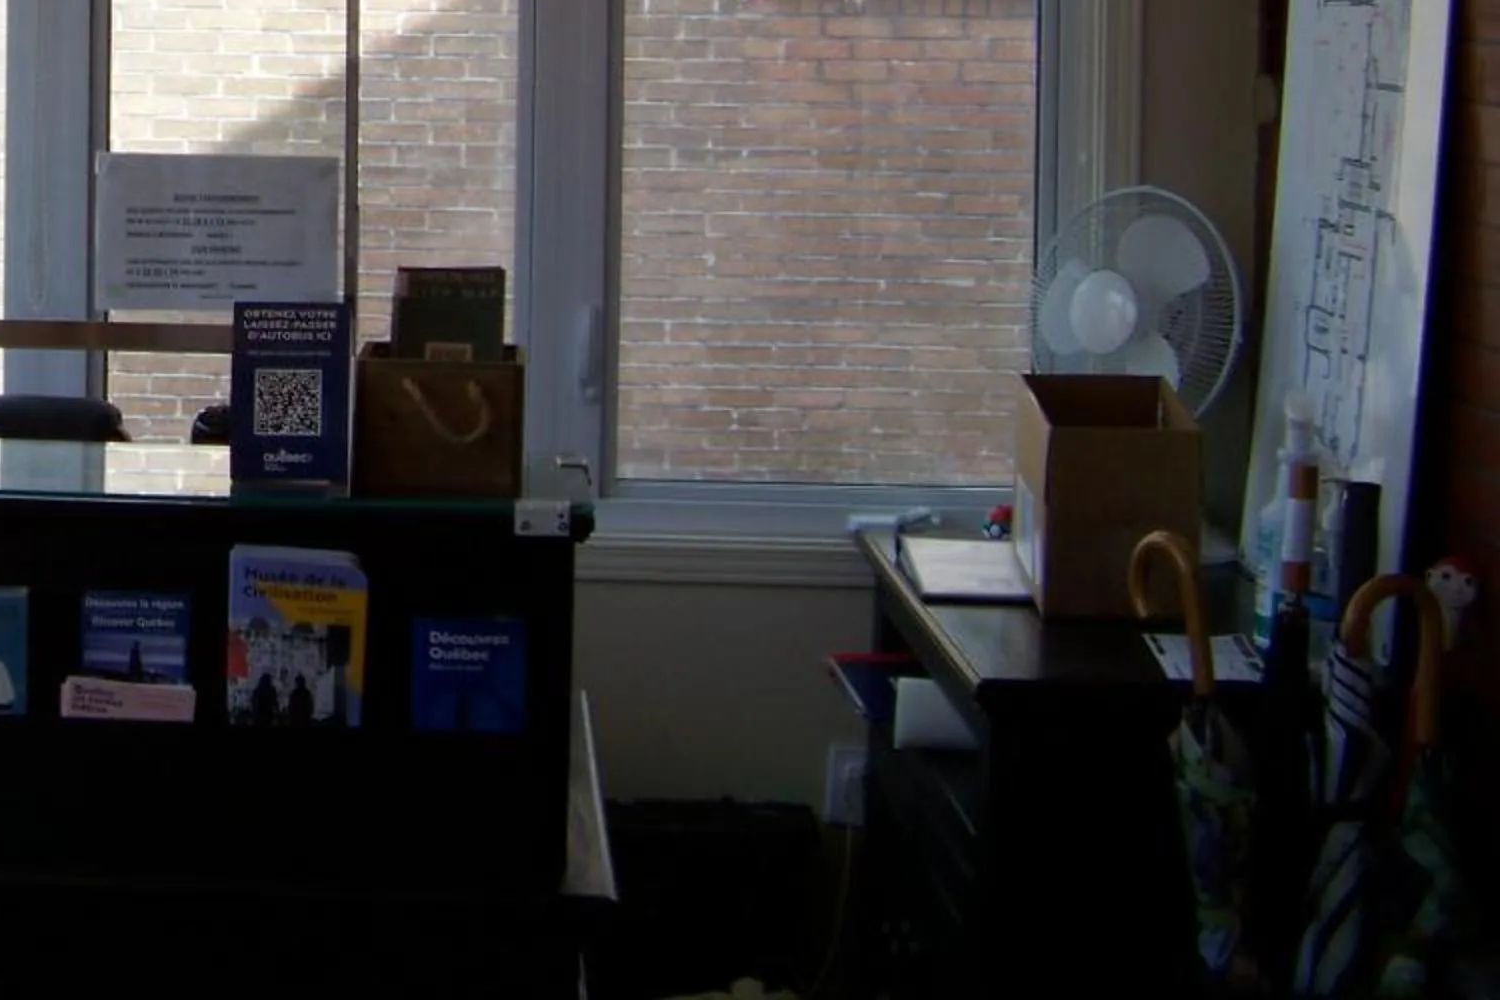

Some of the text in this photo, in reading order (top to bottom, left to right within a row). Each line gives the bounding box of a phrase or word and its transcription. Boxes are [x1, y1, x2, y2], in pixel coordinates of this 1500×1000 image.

[243, 565, 299, 583] Musée
[303, 571, 326, 586] de
[428, 646, 490, 662] Québec
